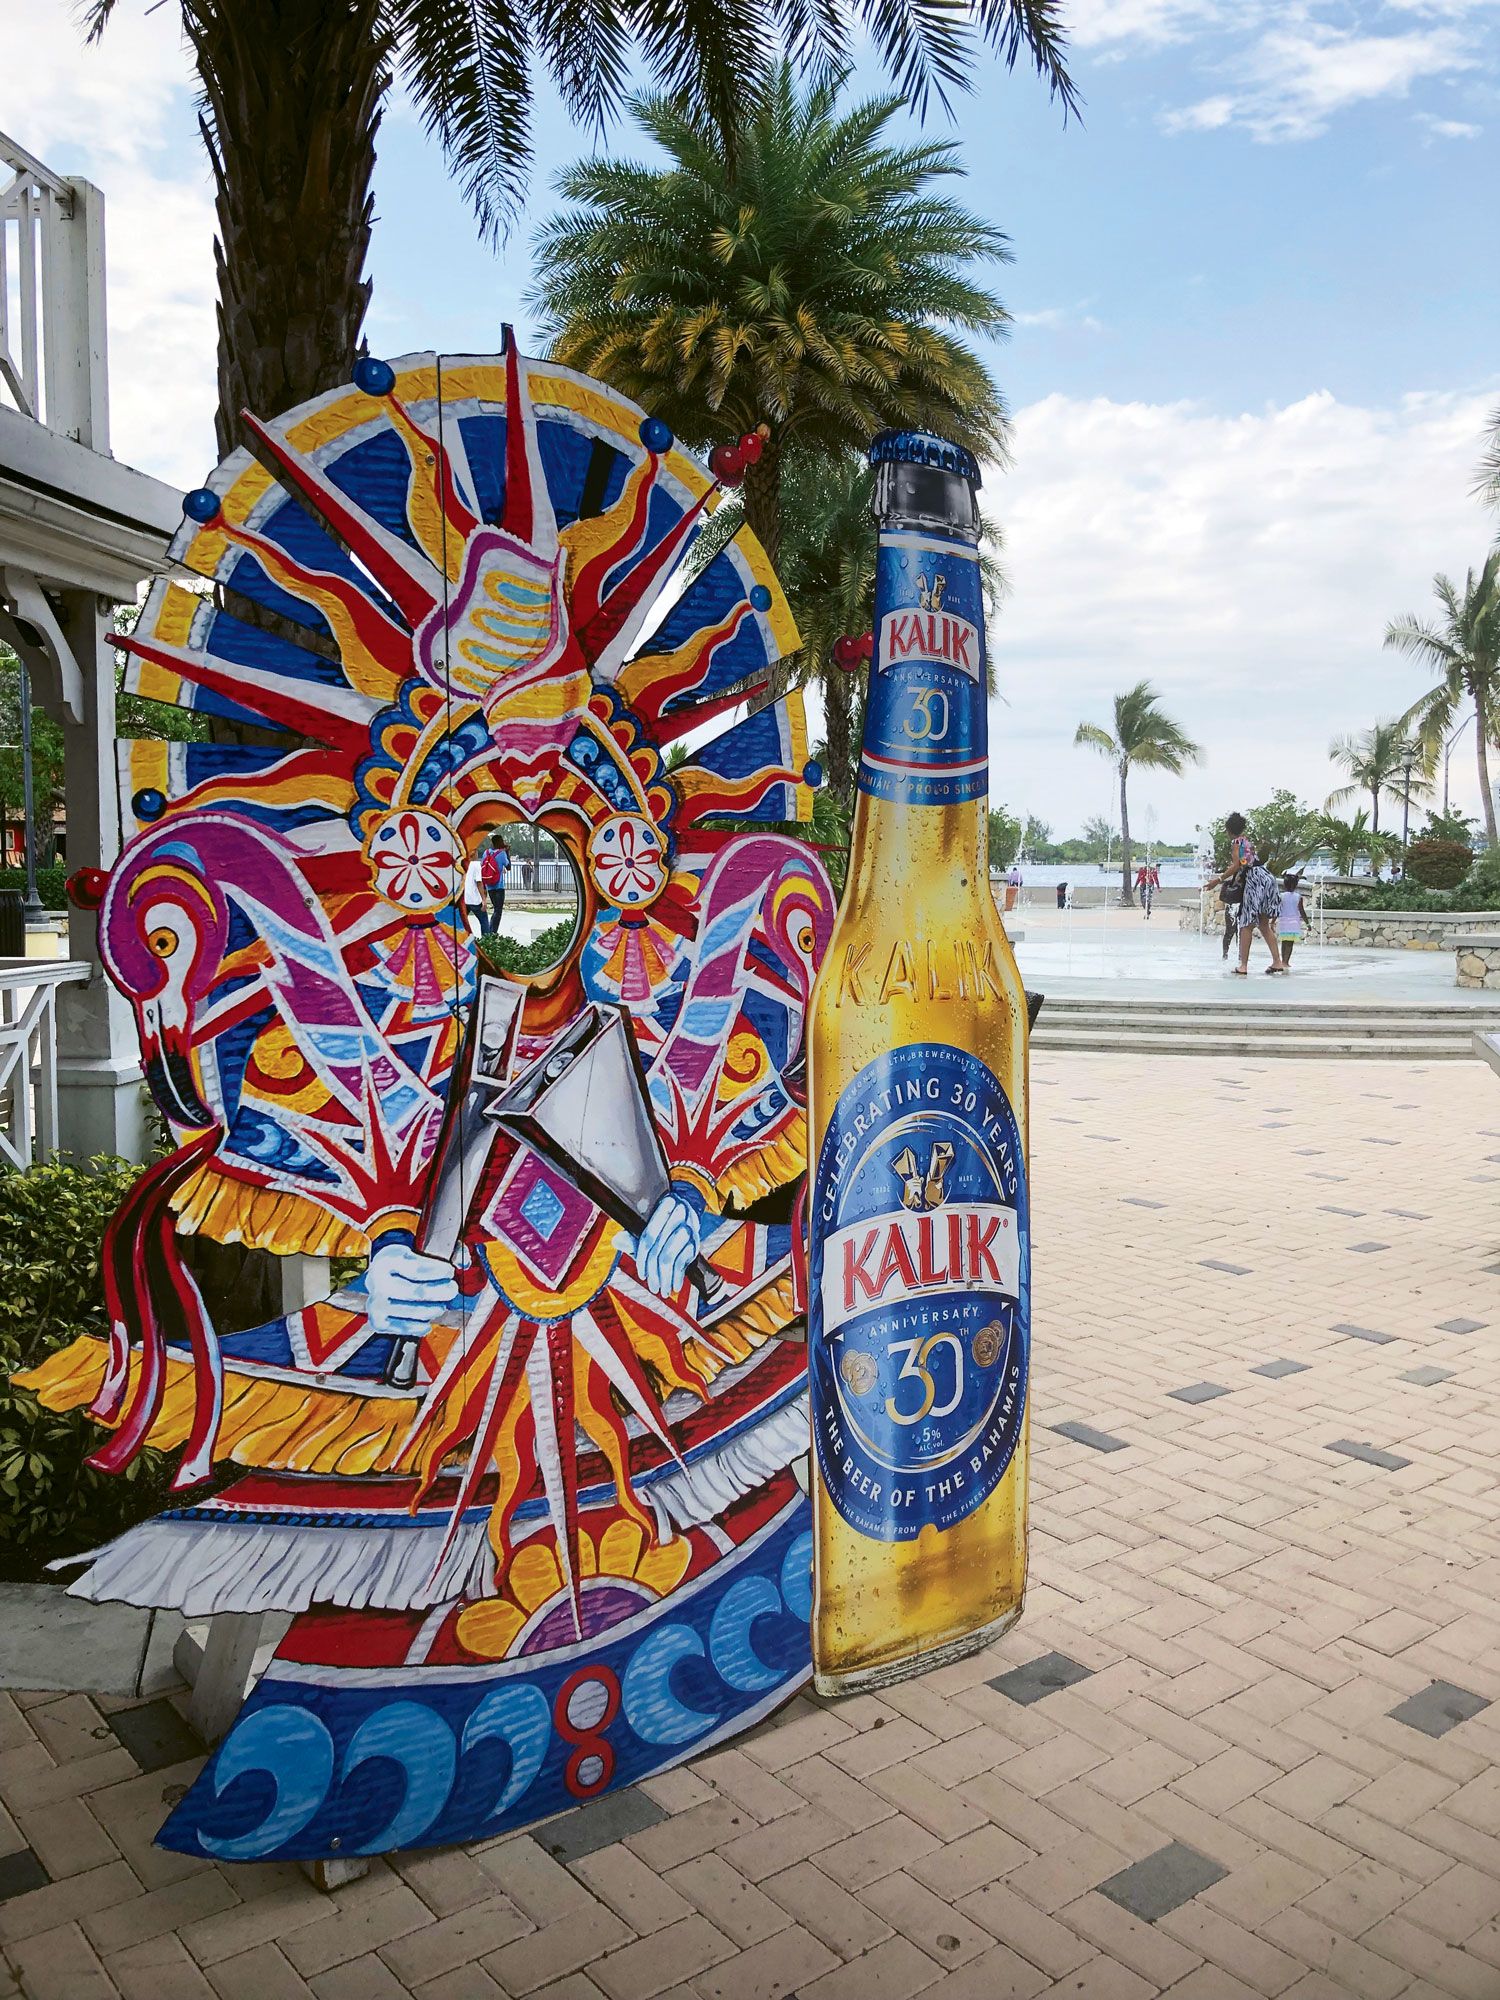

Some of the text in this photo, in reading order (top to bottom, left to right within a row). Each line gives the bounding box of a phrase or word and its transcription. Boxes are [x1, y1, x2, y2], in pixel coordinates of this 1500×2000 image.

[889, 614, 972, 670] KALIK
[893, 671, 966, 689] ANNIVERSARY
[903, 686, 949, 741] 30
[835, 939, 1004, 1008] KALIK
[837, 1054, 906, 1116] COMMONWLTH
[911, 1049, 957, 1062] BREWERY
[822, 1076, 1018, 1222] CELEBRATING 30 YEARS
[958, 1174, 974, 1183] MARK
[842, 1213, 1004, 1312] KALIK
[868, 1305, 979, 1338] ANNIVERSARY
[958, 1326, 970, 1337] TH
[884, 1331, 964, 1426] 30
[824, 1405, 845, 1456] THE
[842, 1455, 883, 1503] BEER
[889, 1488, 917, 1508] OF
[925, 1470, 966, 1504] THE
[969, 1365, 1020, 1475] BAHAMAS
[922, 1426, 942, 1443] 5%
[822, 1458, 837, 1493] BREWED
[835, 1493, 843, 1505] IN
[843, 1503, 854, 1519] THE
[893, 1525, 917, 1535] FROM
[941, 1509, 958, 1524] THE
[961, 1485, 987, 1513] FINEST
[987, 1445, 1013, 1487] SELECTED
